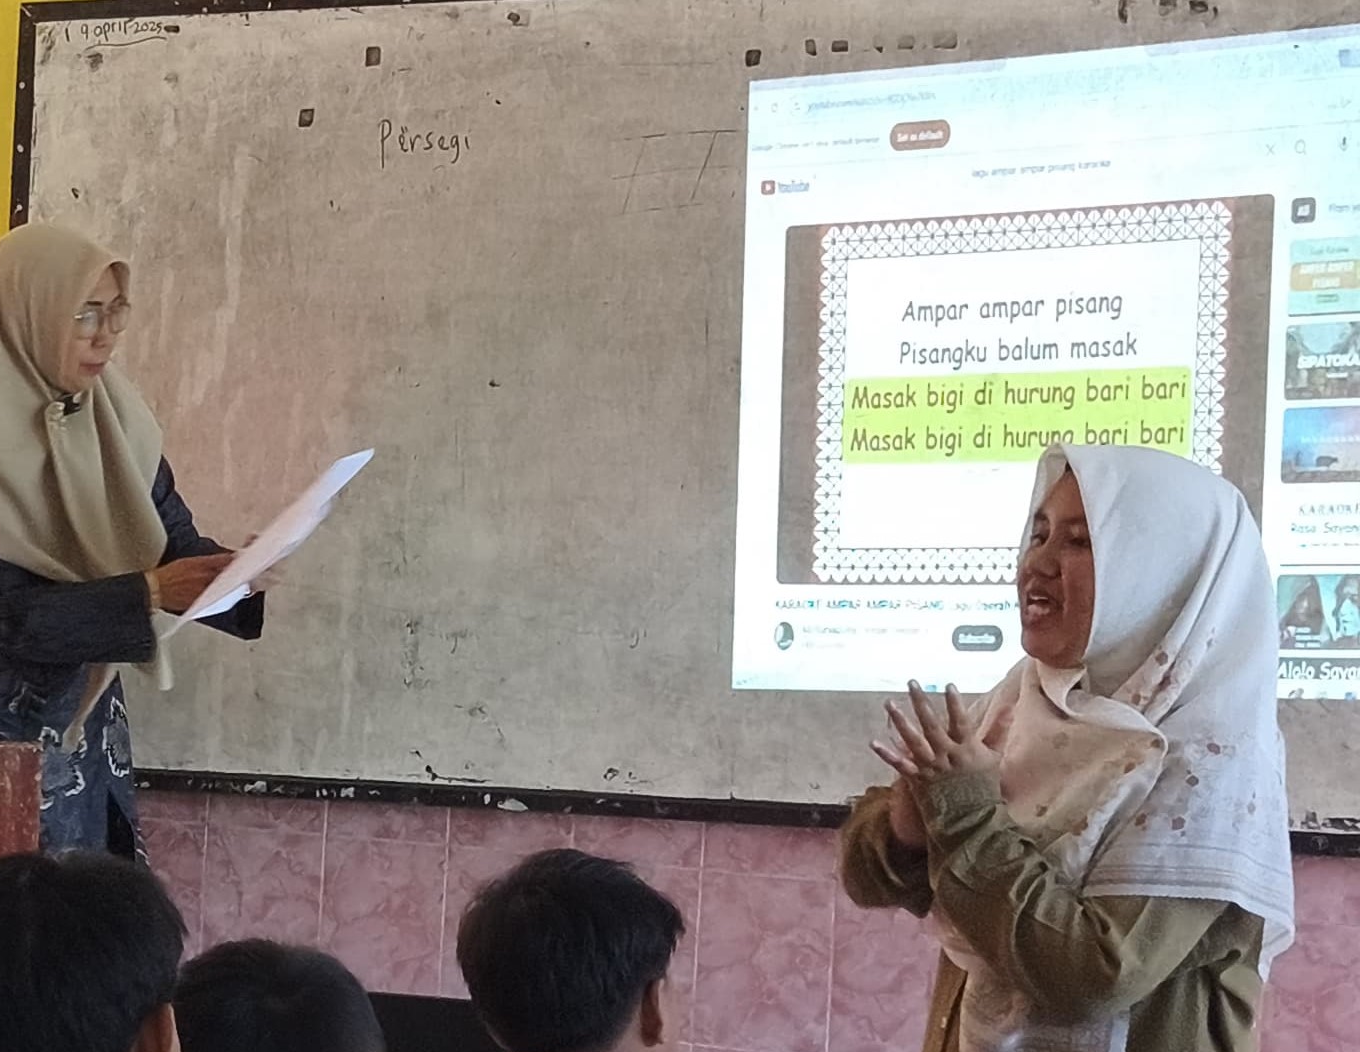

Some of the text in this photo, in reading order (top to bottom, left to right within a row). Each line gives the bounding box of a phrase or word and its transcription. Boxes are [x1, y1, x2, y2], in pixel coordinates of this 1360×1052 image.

[902, 293, 1122, 327] Ampar ampar pisang
[900, 332, 1138, 371] Pisangku balum masak
[851, 375, 1186, 413] Masak bigi di hurung bari bari
[850, 427, 916, 451] Masak
[926, 425, 963, 456] bigi
[973, 424, 992, 448] di
[1085, 421, 1128, 445] bari
[1140, 419, 1185, 444] bari
